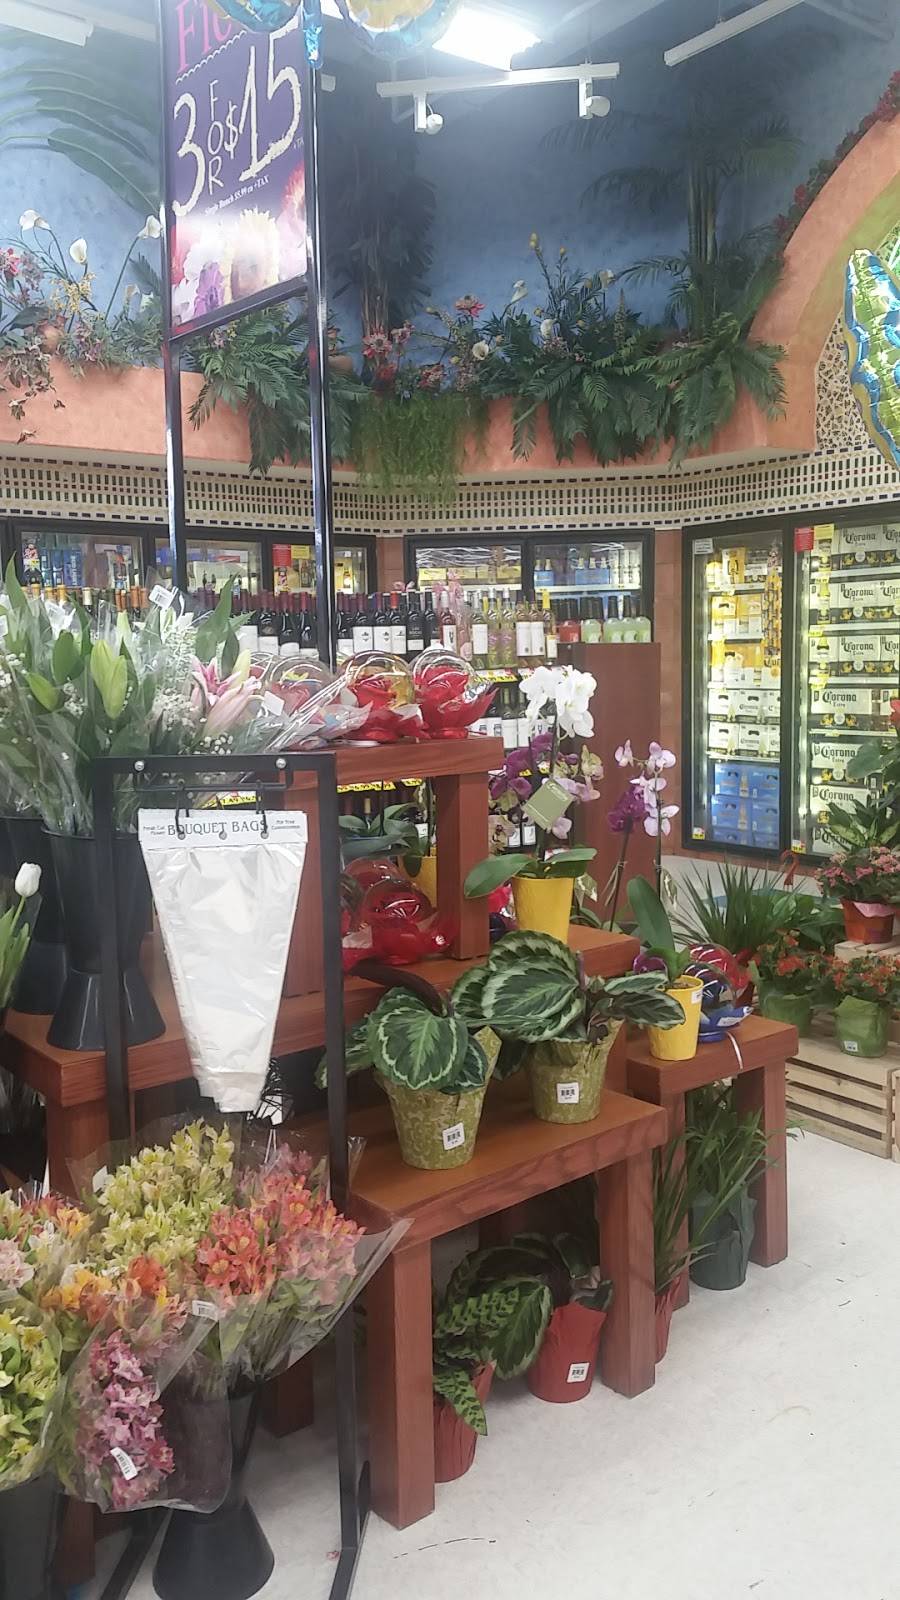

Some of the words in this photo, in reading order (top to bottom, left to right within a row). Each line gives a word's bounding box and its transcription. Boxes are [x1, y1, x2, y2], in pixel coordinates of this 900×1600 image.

[172, 93, 206, 217] 3
[846, 532, 876, 544] Corona
[843, 586, 873, 599] Corona
[844, 642, 873, 653] Corona
[822, 691, 857, 704] Corona
[821, 746, 856, 759] Corona
[820, 788, 855, 801] Corona
[167, 821, 227, 836] BOUQUET
[232, 820, 266, 833] BAGS
